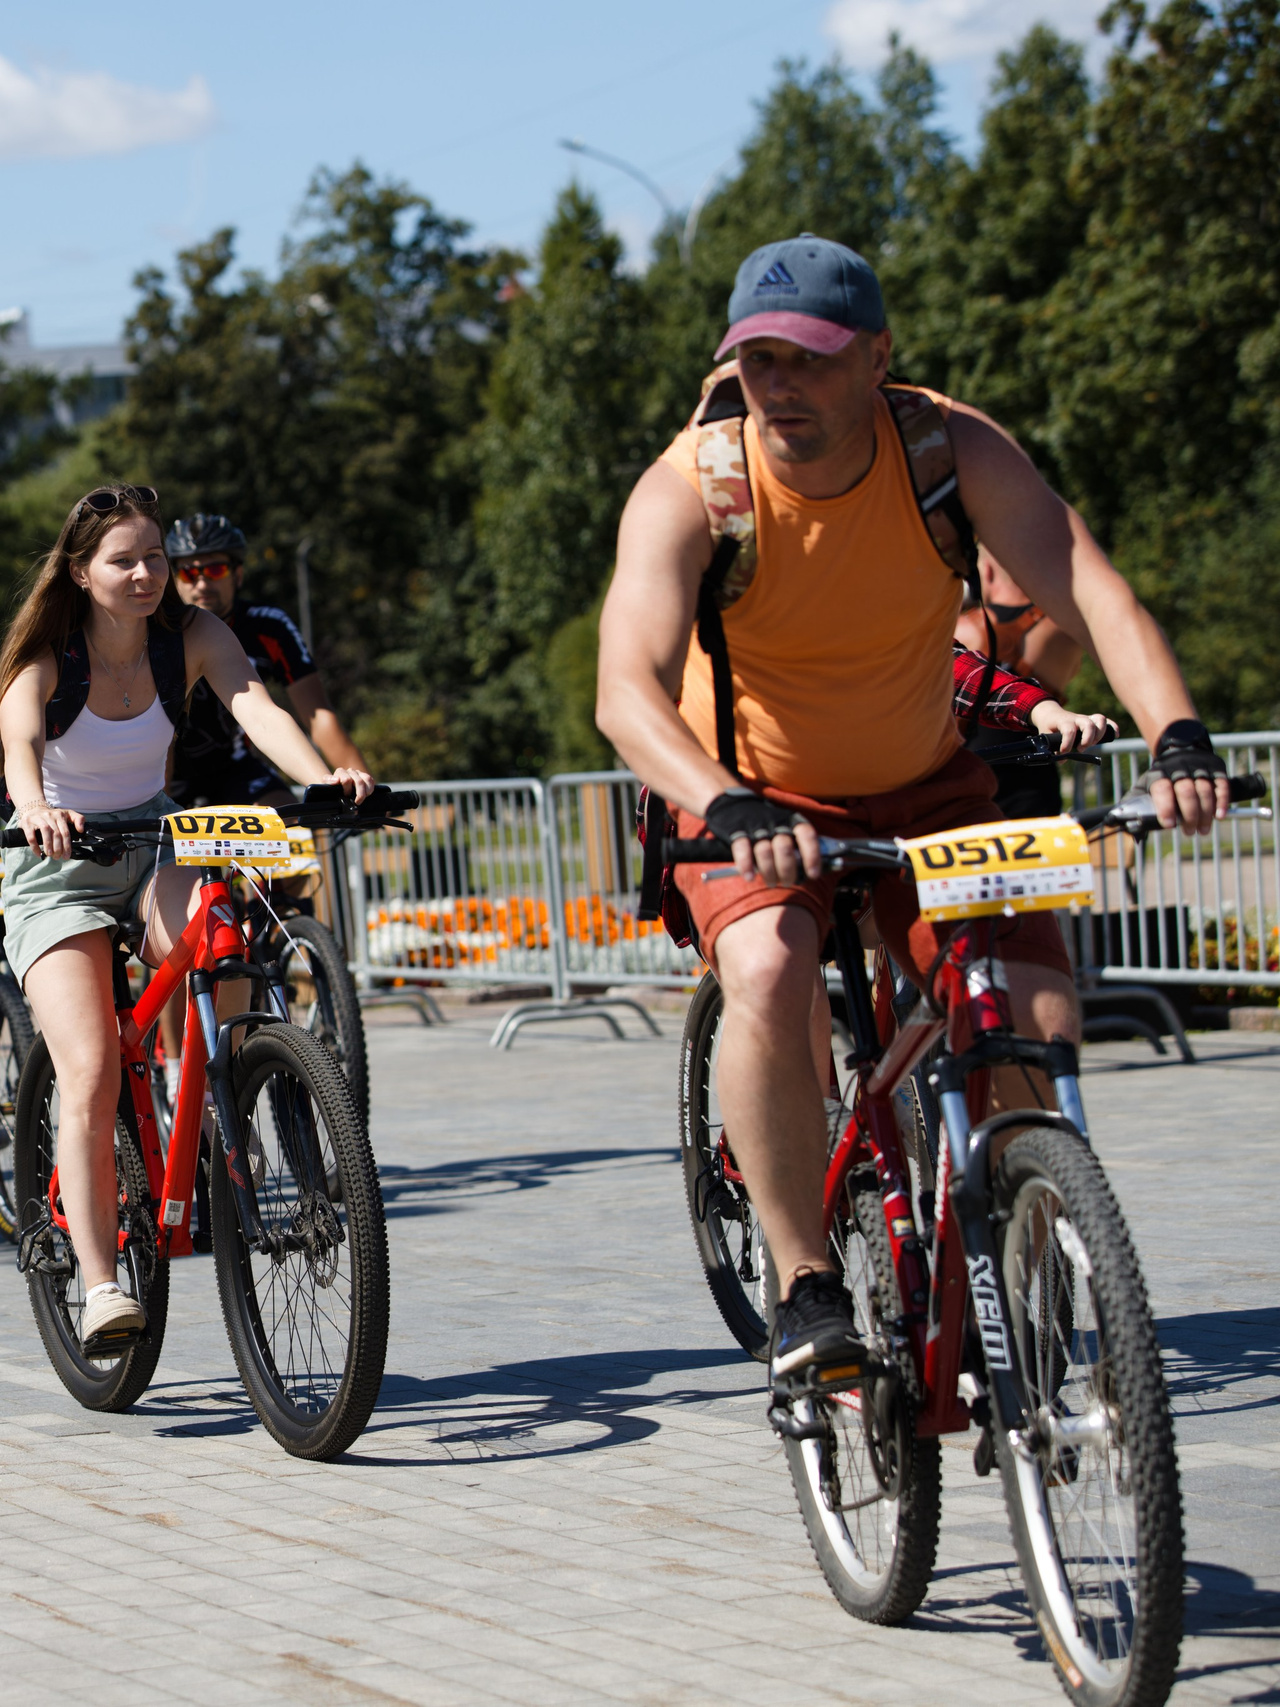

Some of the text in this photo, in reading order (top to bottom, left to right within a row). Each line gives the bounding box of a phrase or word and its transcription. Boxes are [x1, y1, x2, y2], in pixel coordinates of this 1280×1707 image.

[174, 815, 264, 835] 0728
[920, 833, 1042, 870] 0512
[683, 1048, 693, 1103] TERRAINS
[683, 1105, 691, 1129] ALL
